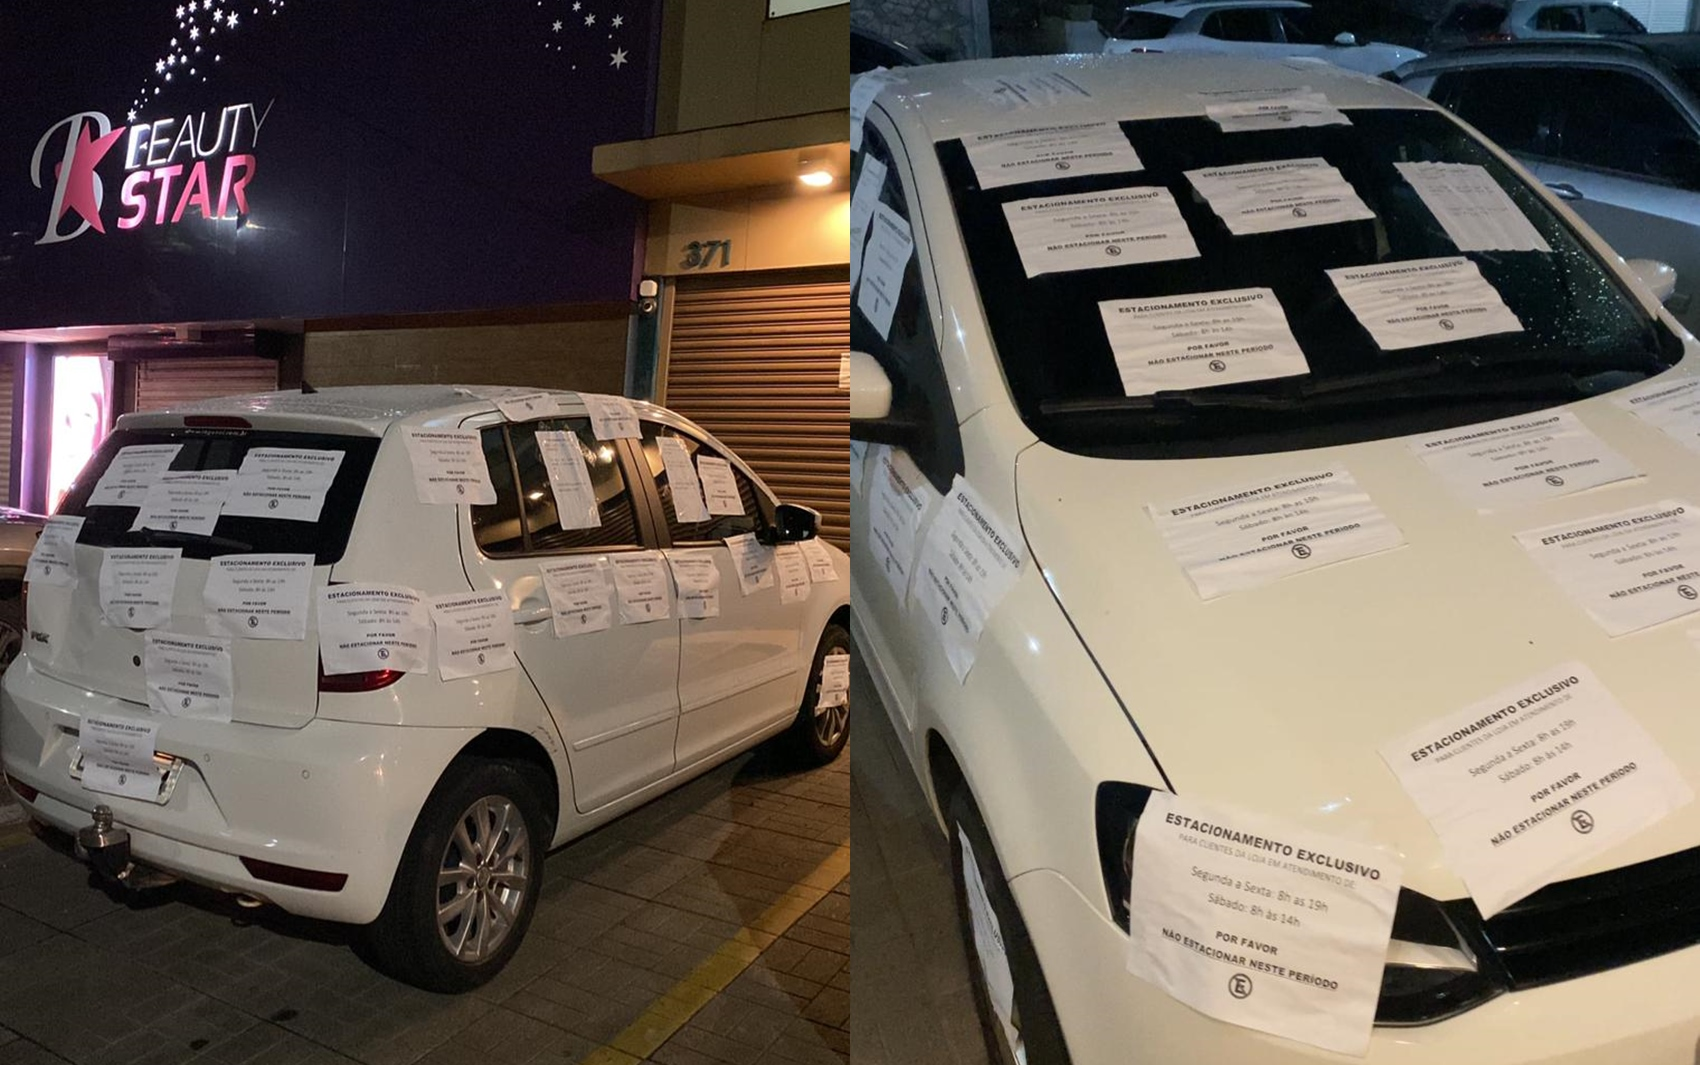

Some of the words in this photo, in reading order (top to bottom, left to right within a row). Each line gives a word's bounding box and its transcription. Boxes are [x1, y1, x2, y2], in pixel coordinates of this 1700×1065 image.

[125, 97, 275, 170] BEAUTY
[117, 154, 256, 229] STAR
[1021, 196, 1106, 211] ESTACIONAMENTO
[1109, 192, 1158, 201] EXCLUSIVO
[679, 240, 731, 270] 371
[1065, 239, 1109, 248] ESTACIONAR
[1345, 268, 1417, 280] ESTACIONAMENTO
[1419, 261, 1463, 271] EXCLUSIVO
[1119, 300, 1207, 313] ESTACIONAMENTO
[1210, 294, 1263, 305] EXCLUSIVO
[1166, 352, 1213, 363] ESTACIONAR
[1216, 349, 1239, 357] NESTE
[1205, 341, 1229, 349] FAVOR
[1424, 427, 1508, 448] ESTACIONAMENTO
[1510, 417, 1559, 431] EXCLUSIVO
[1500, 470, 1543, 484] ESTACIONAR
[1171, 486, 1272, 516] ESTACIONAMENTO
[1274, 472, 1333, 490] EXCLUSIVO
[957, 493, 996, 539] ESTACIONAMENTO
[993, 536, 1020, 569] EXCLUSIVO
[1280, 526, 1309, 537] FAVOR
[1295, 532, 1322, 542] NESTE
[1541, 520, 1630, 545] ESTACIONAMENTO
[1631, 507, 1685, 524] EXCLUSIVO
[1628, 578, 1675, 594] ESTACIONAR
[1642, 570, 1659, 578] POR
[1659, 564, 1685, 574] FAVOR
[328, 590, 388, 600] ESTACIONAMENTO
[436, 599, 477, 609] ESTACIONAMENTO
[1411, 705, 1517, 762] ESTACIONAMENTO
[1517, 676, 1579, 709] EXCLUSIVO
[1468, 754, 1507, 777] Segunda
[1507, 751, 1512, 759] a
[1512, 738, 1536, 755] Sexta:
[1537, 732, 1550, 742] 8h
[1558, 718, 1576, 732] 19h
[1498, 762, 1531, 783] Sábado:
[1532, 754, 1545, 766] 8h
[1556, 741, 1573, 754] 14h
[1530, 788, 1551, 803] POR
[1551, 772, 1581, 793] FAVOR
[1490, 830, 1513, 847] NÃO
[1512, 798, 1571, 835] ESTACIONAR
[1570, 783, 1599, 804] NESTE
[1166, 813, 1292, 856] ESTACIONAMENTO
[1297, 849, 1380, 880] EXCLUSIVO
[1179, 834, 1199, 846] PARA
[1235, 846, 1245, 858] DA
[1268, 856, 1281, 867] EM
[1282, 862, 1342, 888] ATENDIMENTO
[1191, 865, 1233, 888] Segunda
[1235, 880, 1241, 889] a
[1244, 881, 1273, 897] Sexta:
[1278, 890, 1291, 902] 8h
[1308, 899, 1328, 913] 19h
[1208, 892, 1248, 913] Sábado:
[1250, 906, 1263, 917] 8h
[1281, 914, 1300, 927] 14h
[1162, 927, 1182, 942] NÃO
[1184, 937, 1246, 965] ESTACIONAR
[1249, 960, 1285, 977] NESTE
[1289, 969, 1338, 990] PERÍODO
[1216, 931, 1239, 944] POR
[1240, 938, 1278, 956] FAVOR
